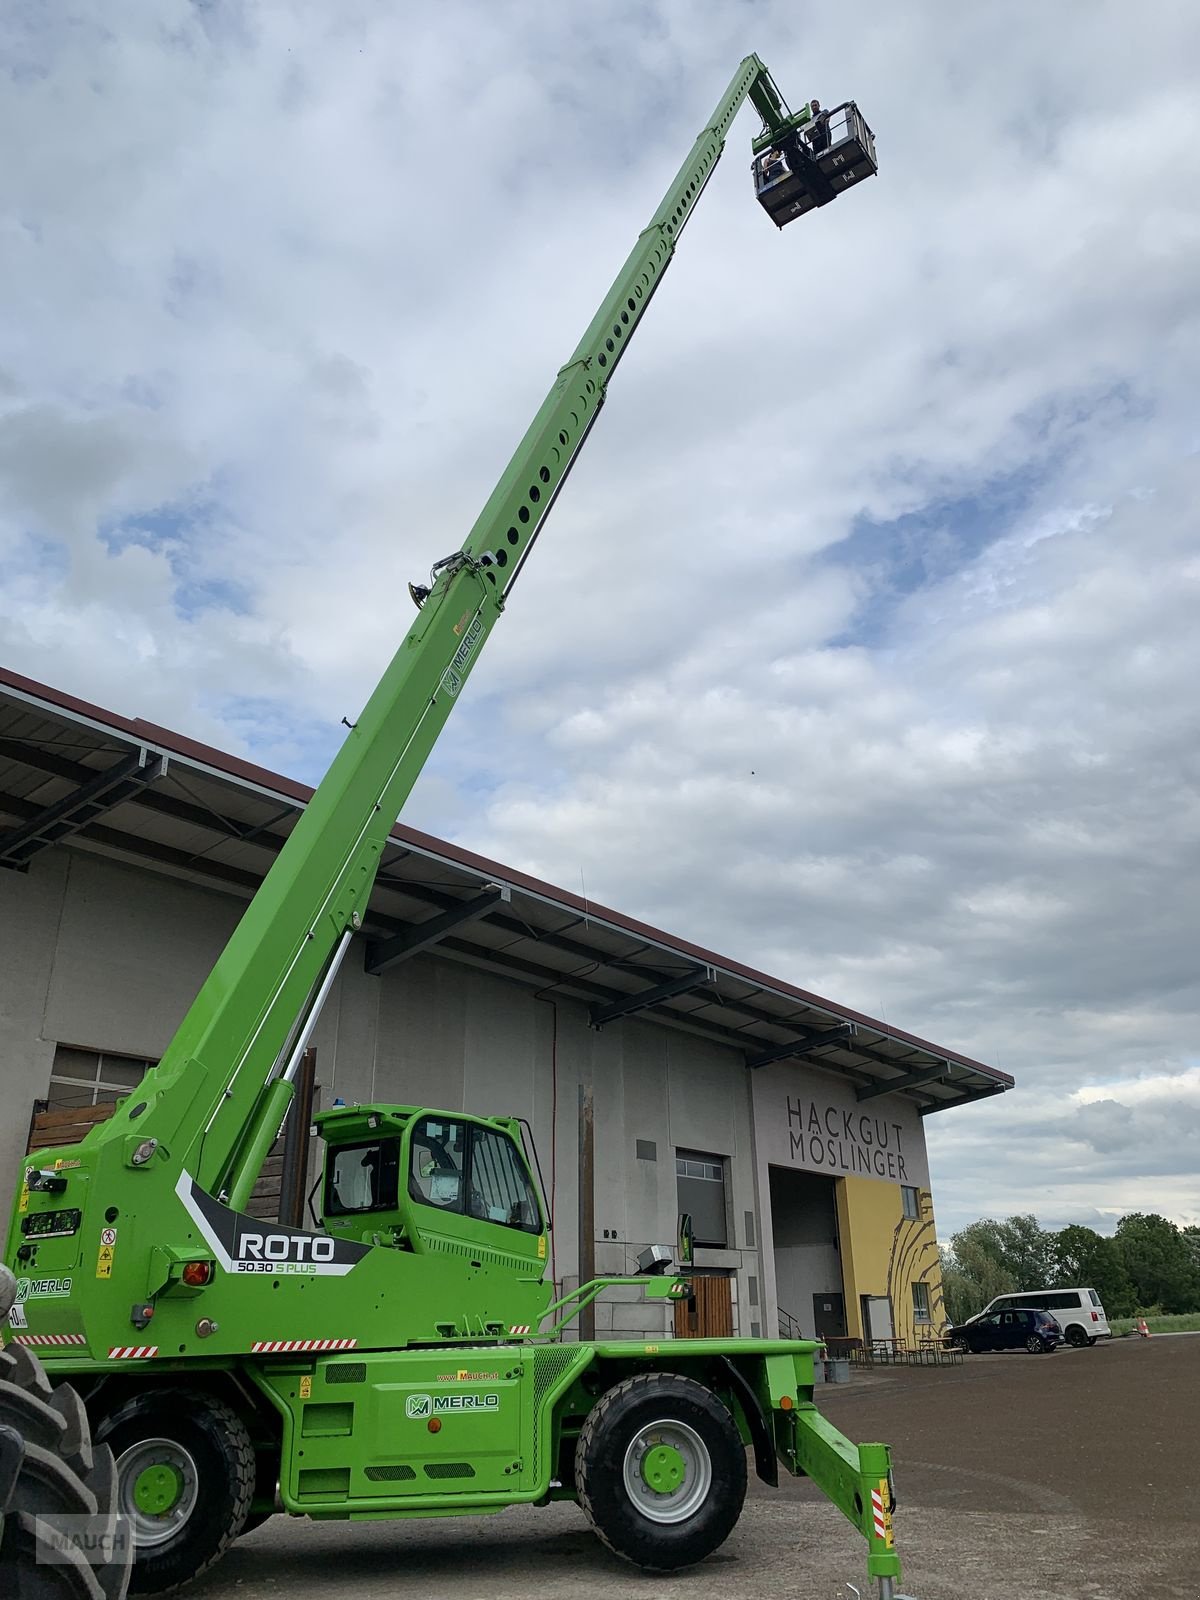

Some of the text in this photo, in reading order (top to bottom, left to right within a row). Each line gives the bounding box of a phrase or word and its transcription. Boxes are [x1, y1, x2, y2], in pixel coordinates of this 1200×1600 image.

[453, 619, 482, 669] MERLO
[786, 1095, 903, 1153] HACKGUT
[789, 1130, 908, 1181] MÖSLINGER
[239, 1233, 335, 1262] ROTO
[237, 1262, 317, 1274] 50.30 S PLUS
[30, 1279, 72, 1293] MERLO
[434, 1395, 498, 1408] MERLO
